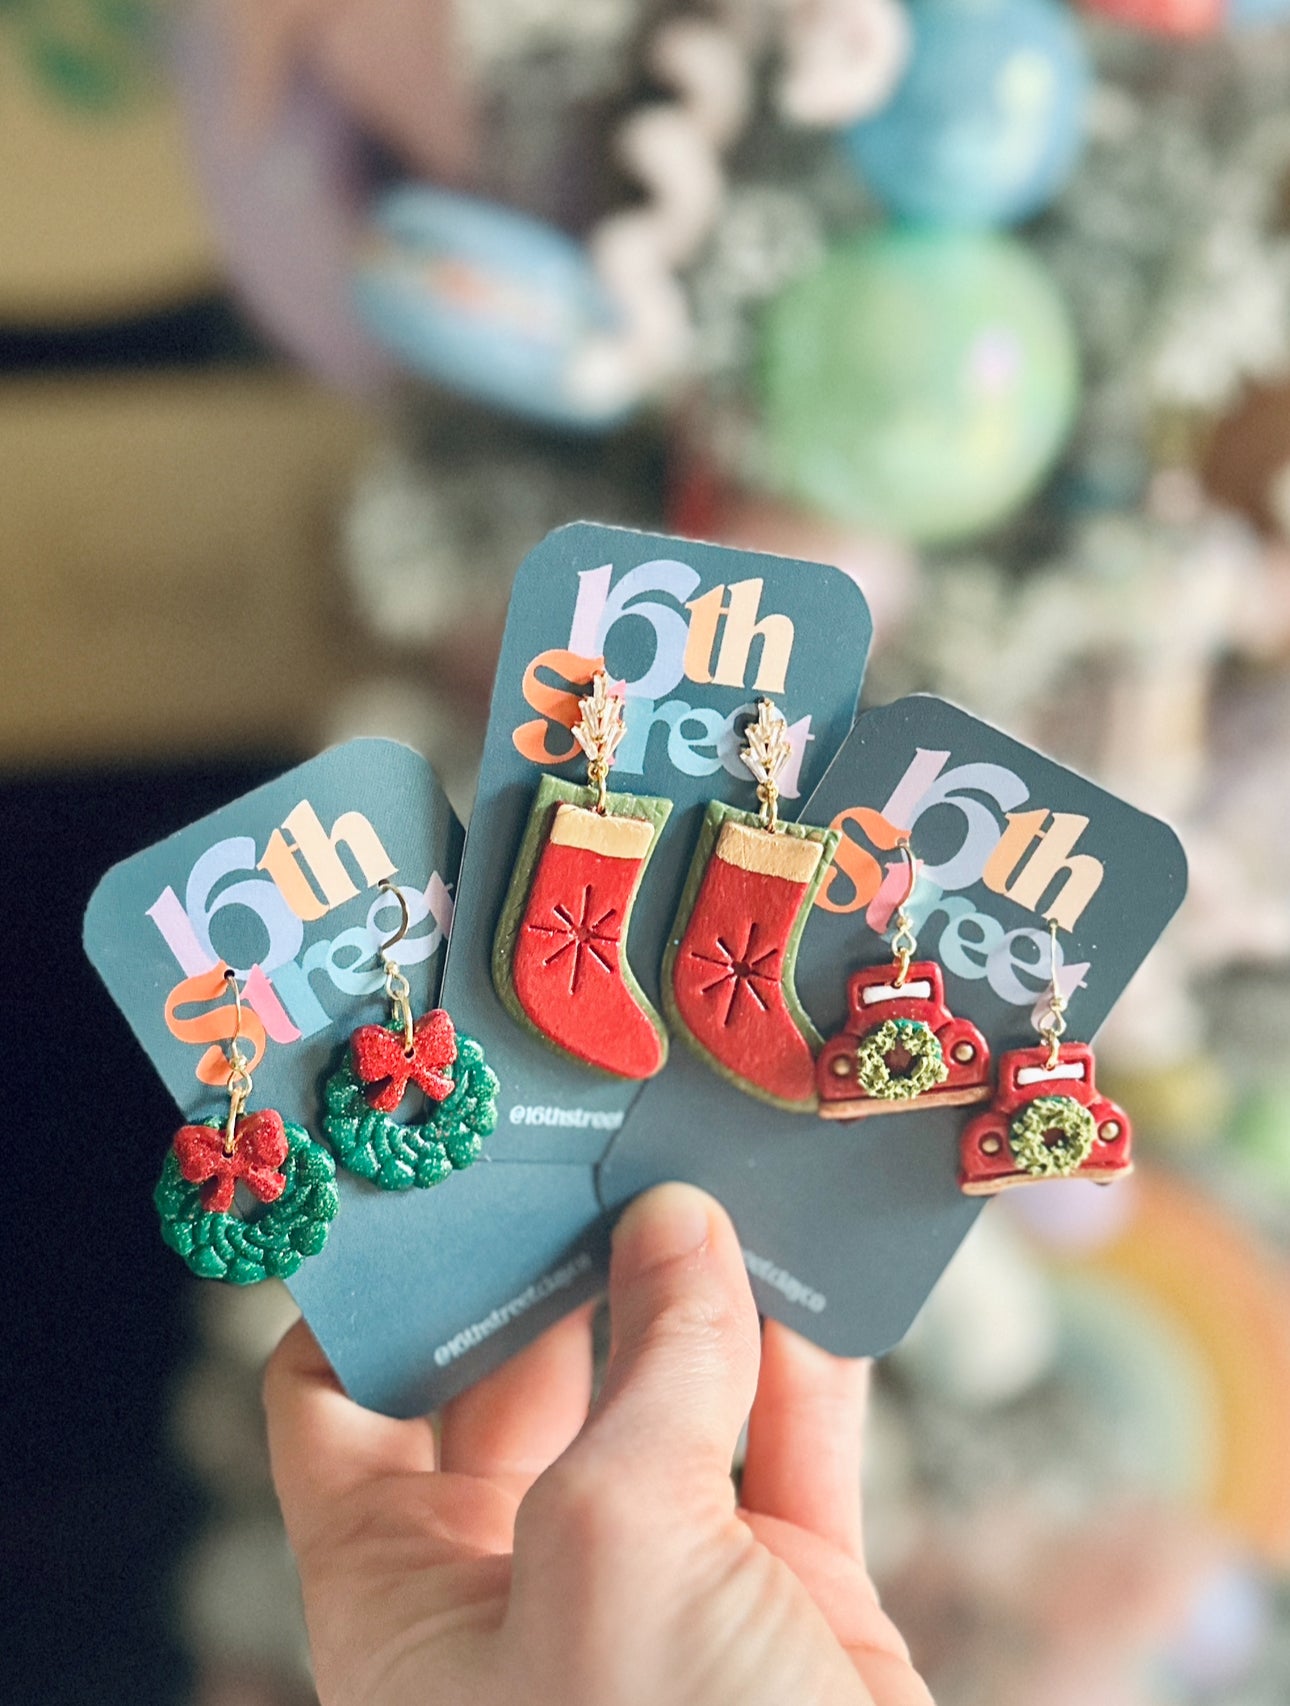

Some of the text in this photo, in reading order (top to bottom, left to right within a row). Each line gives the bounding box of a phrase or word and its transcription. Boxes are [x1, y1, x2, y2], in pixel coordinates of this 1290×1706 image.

[567, 559, 795, 700] 16th
[145, 799, 399, 980] 16th
[880, 747, 1104, 933] 16th
